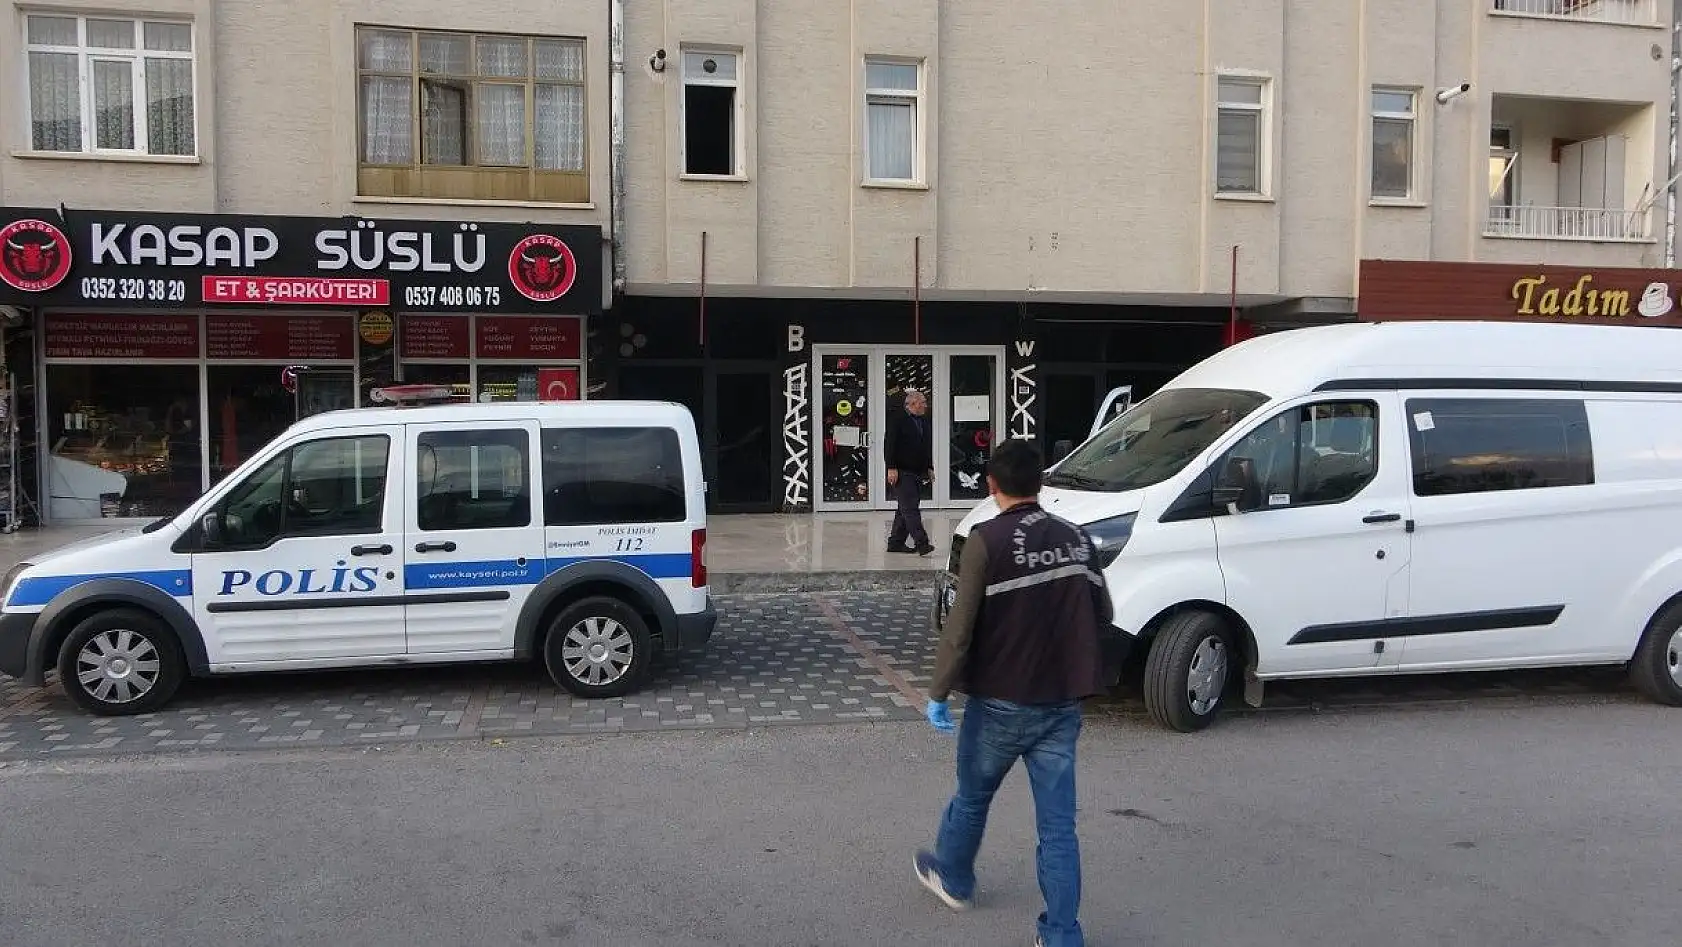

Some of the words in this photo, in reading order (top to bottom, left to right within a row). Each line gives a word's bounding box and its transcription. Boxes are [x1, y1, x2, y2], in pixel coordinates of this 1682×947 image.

[92, 223, 279, 267] KASAP
[315, 221, 486, 273] SÜSLÜ
[82, 277, 116, 299] 0352
[119, 278, 145, 300] 320
[149, 279, 164, 301] 38
[168, 280, 185, 302] 20
[215, 281, 237, 296] ET
[245, 282, 261, 298] &
[264, 279, 377, 302] ŞARKÜTERİ
[405, 286, 436, 306] 0537
[439, 286, 463, 306] 408
[466, 286, 482, 307] 06
[484, 286, 501, 307] 75
[1512, 274, 1631, 317] Tadım
[788, 325, 805, 352] B
[1014, 340, 1036, 357] W
[615, 538, 643, 551] 112
[1012, 528, 1027, 565] OLAY
[1026, 543, 1089, 568] POLİS
[217, 559, 378, 595] POLİS
[427, 568, 529, 580] www.kayseri.pol.tr
